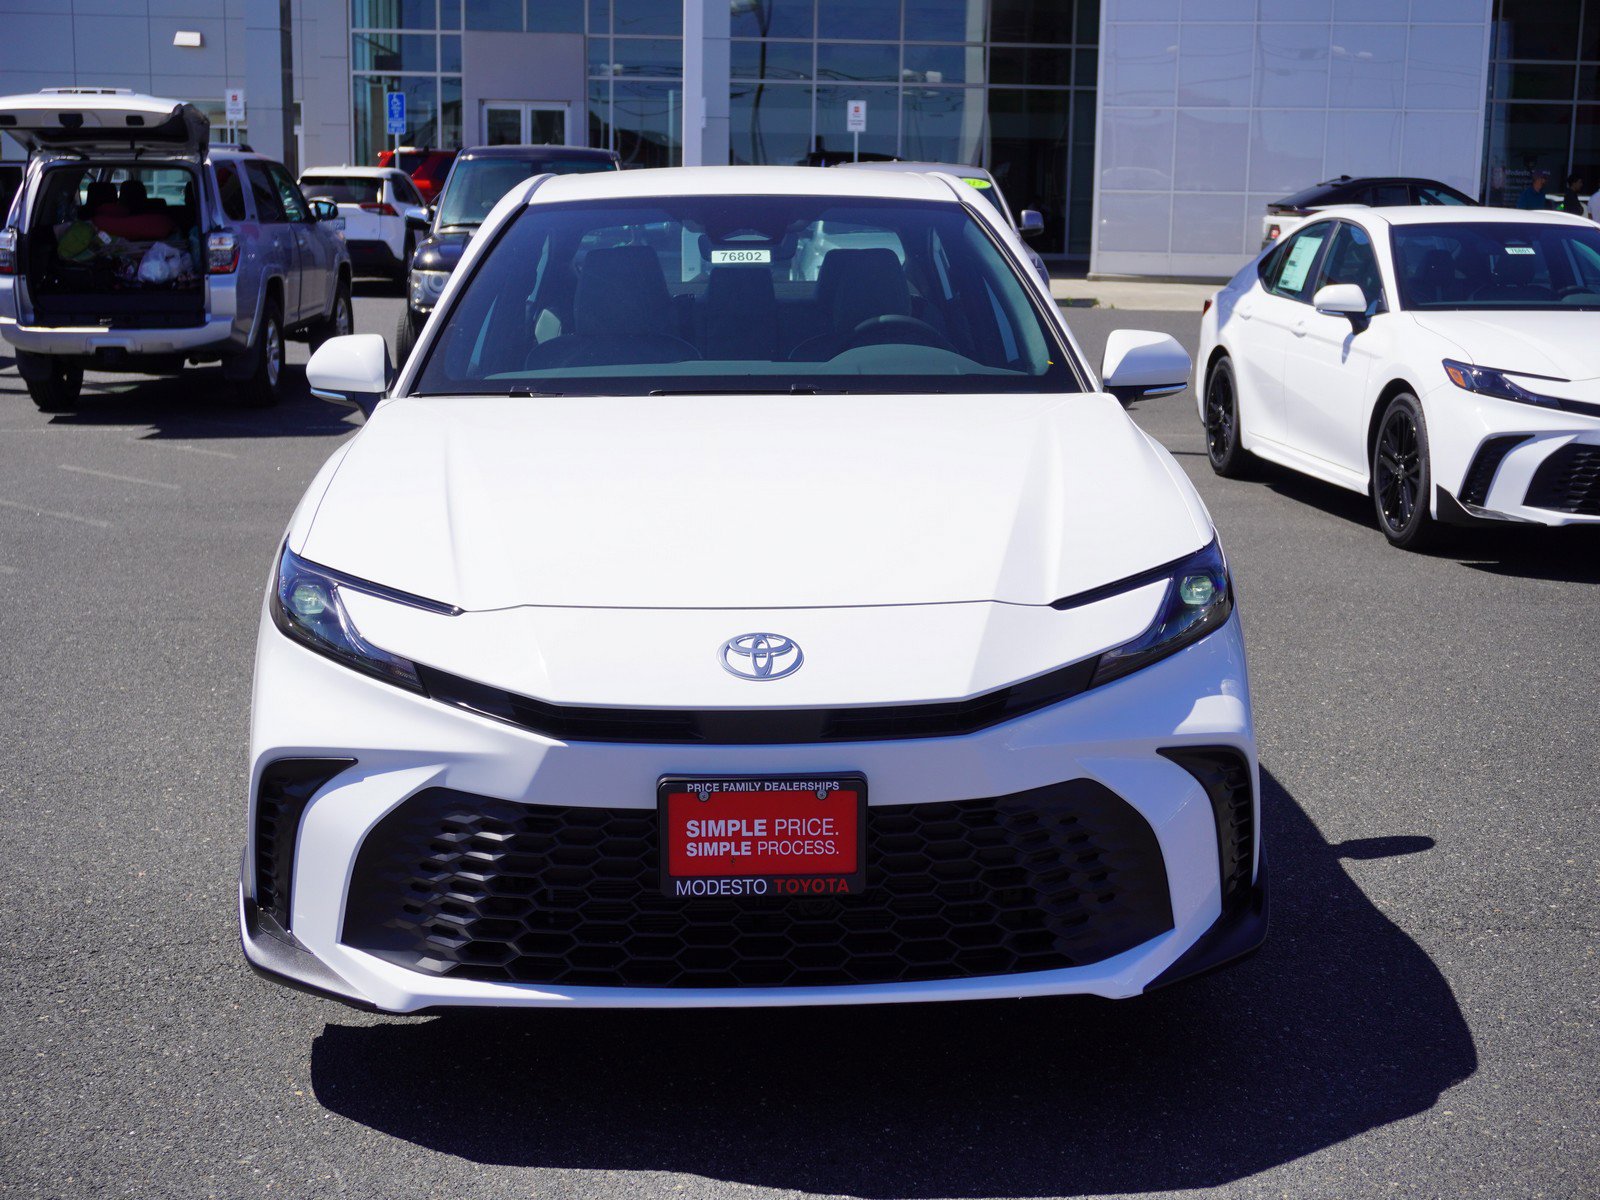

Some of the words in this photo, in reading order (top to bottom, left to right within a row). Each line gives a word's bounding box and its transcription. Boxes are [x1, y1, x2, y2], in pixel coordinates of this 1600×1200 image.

[720, 251, 762, 261] 76802
[687, 783, 720, 793] PRICE
[722, 782, 761, 792] FAMILY
[764, 781, 840, 792] DEALERSHIPS
[686, 819, 767, 838] SIMPLE
[774, 818, 839, 836] PRICE.
[686, 841, 752, 857] SIMPLE
[757, 840, 840, 856] PROCESS.
[676, 878, 767, 896] MODESTO
[774, 878, 849, 894] TOYOTA
